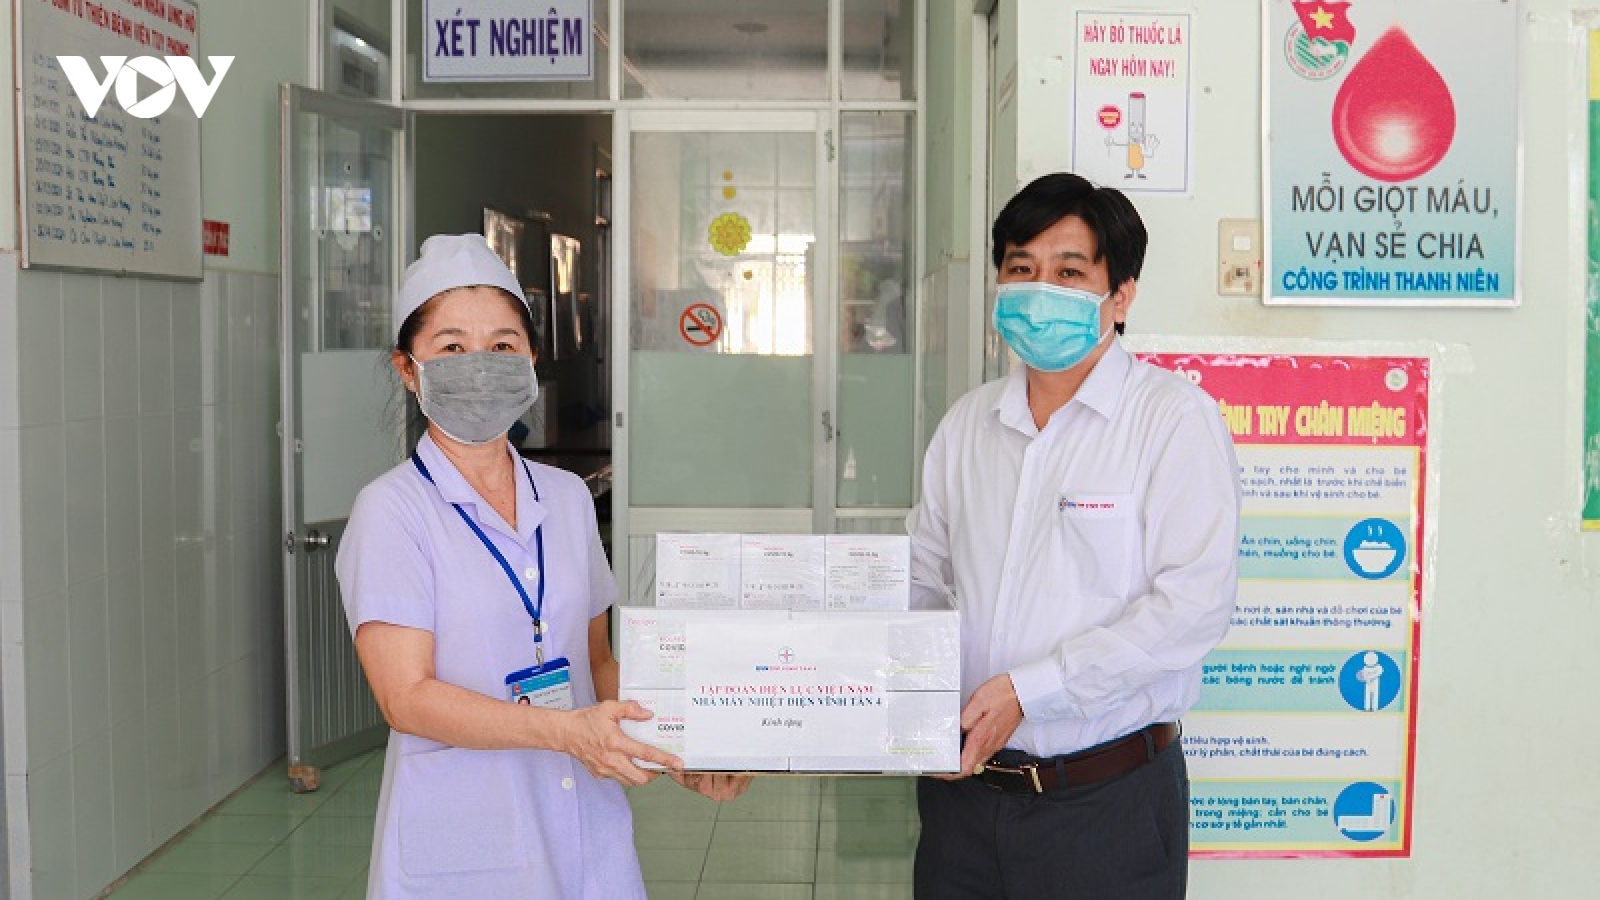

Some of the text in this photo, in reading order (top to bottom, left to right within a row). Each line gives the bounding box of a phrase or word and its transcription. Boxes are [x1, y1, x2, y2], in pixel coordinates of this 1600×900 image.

[435, 6, 583, 65] XÉT NGHIỆM
[1083, 18, 1182, 45] HÃY BỎ THUỐC LÁ
[1089, 54, 1175, 78] NGAY HÔM NAY!
[1291, 172, 1499, 219] MỖI GIỌT MÁU,
[1305, 219, 1485, 264] VẠN SẺ CHIA
[1282, 265, 1499, 293] CÔNG TRÌNH THANH NIÊN
[1256, 405, 1291, 436] TAY
[1295, 399, 1344, 436] CHÂN
[1347, 399, 1407, 444] MIỆNG
[1202, 664, 1228, 675] gười
